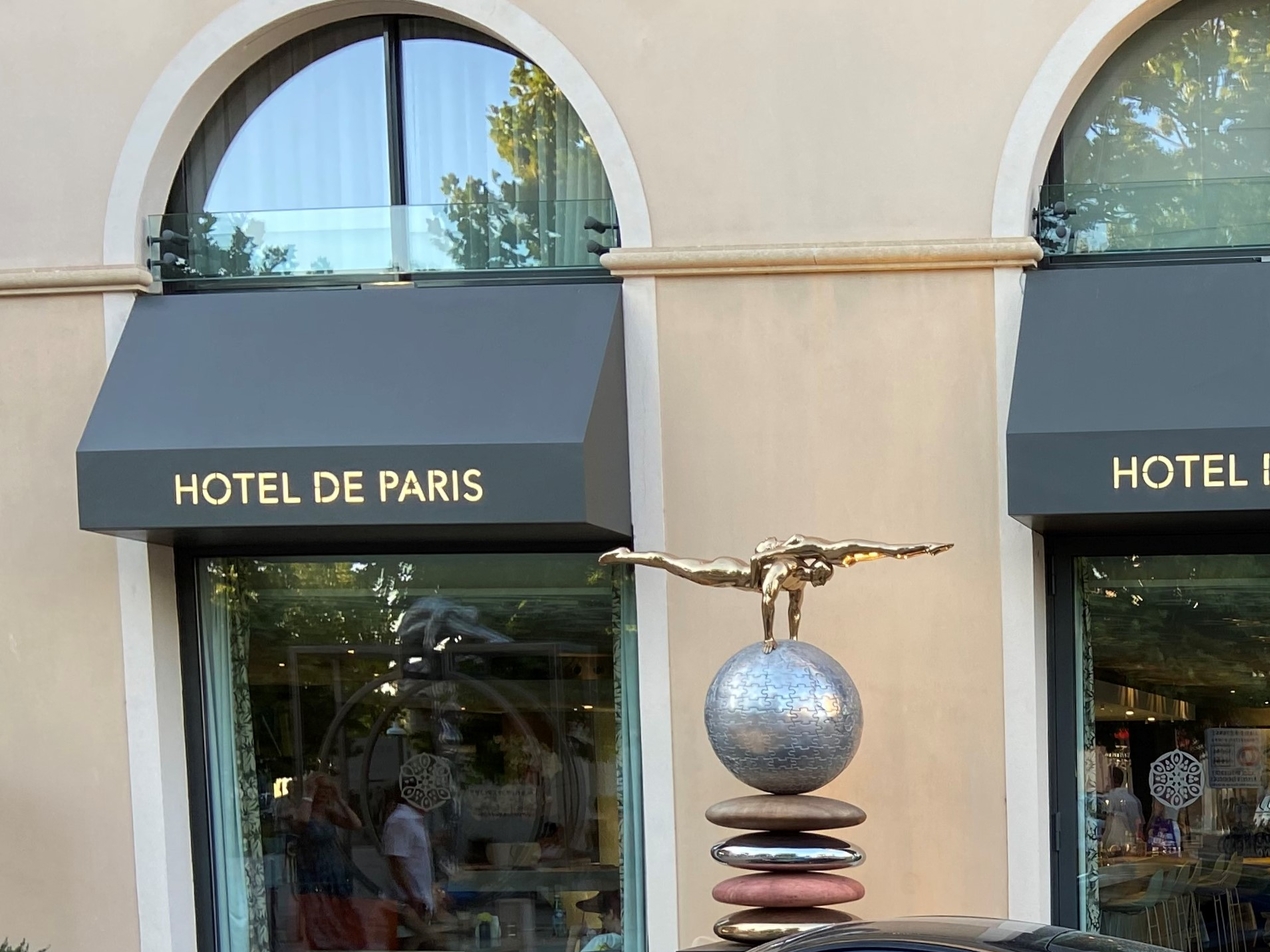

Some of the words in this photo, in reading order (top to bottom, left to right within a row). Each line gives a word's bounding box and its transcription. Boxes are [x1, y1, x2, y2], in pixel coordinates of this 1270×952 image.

[175, 472, 301, 506] HOTEL
[313, 471, 365, 503] DE
[379, 468, 484, 503] PARIS
[1113, 454, 1249, 489] HOTEL
